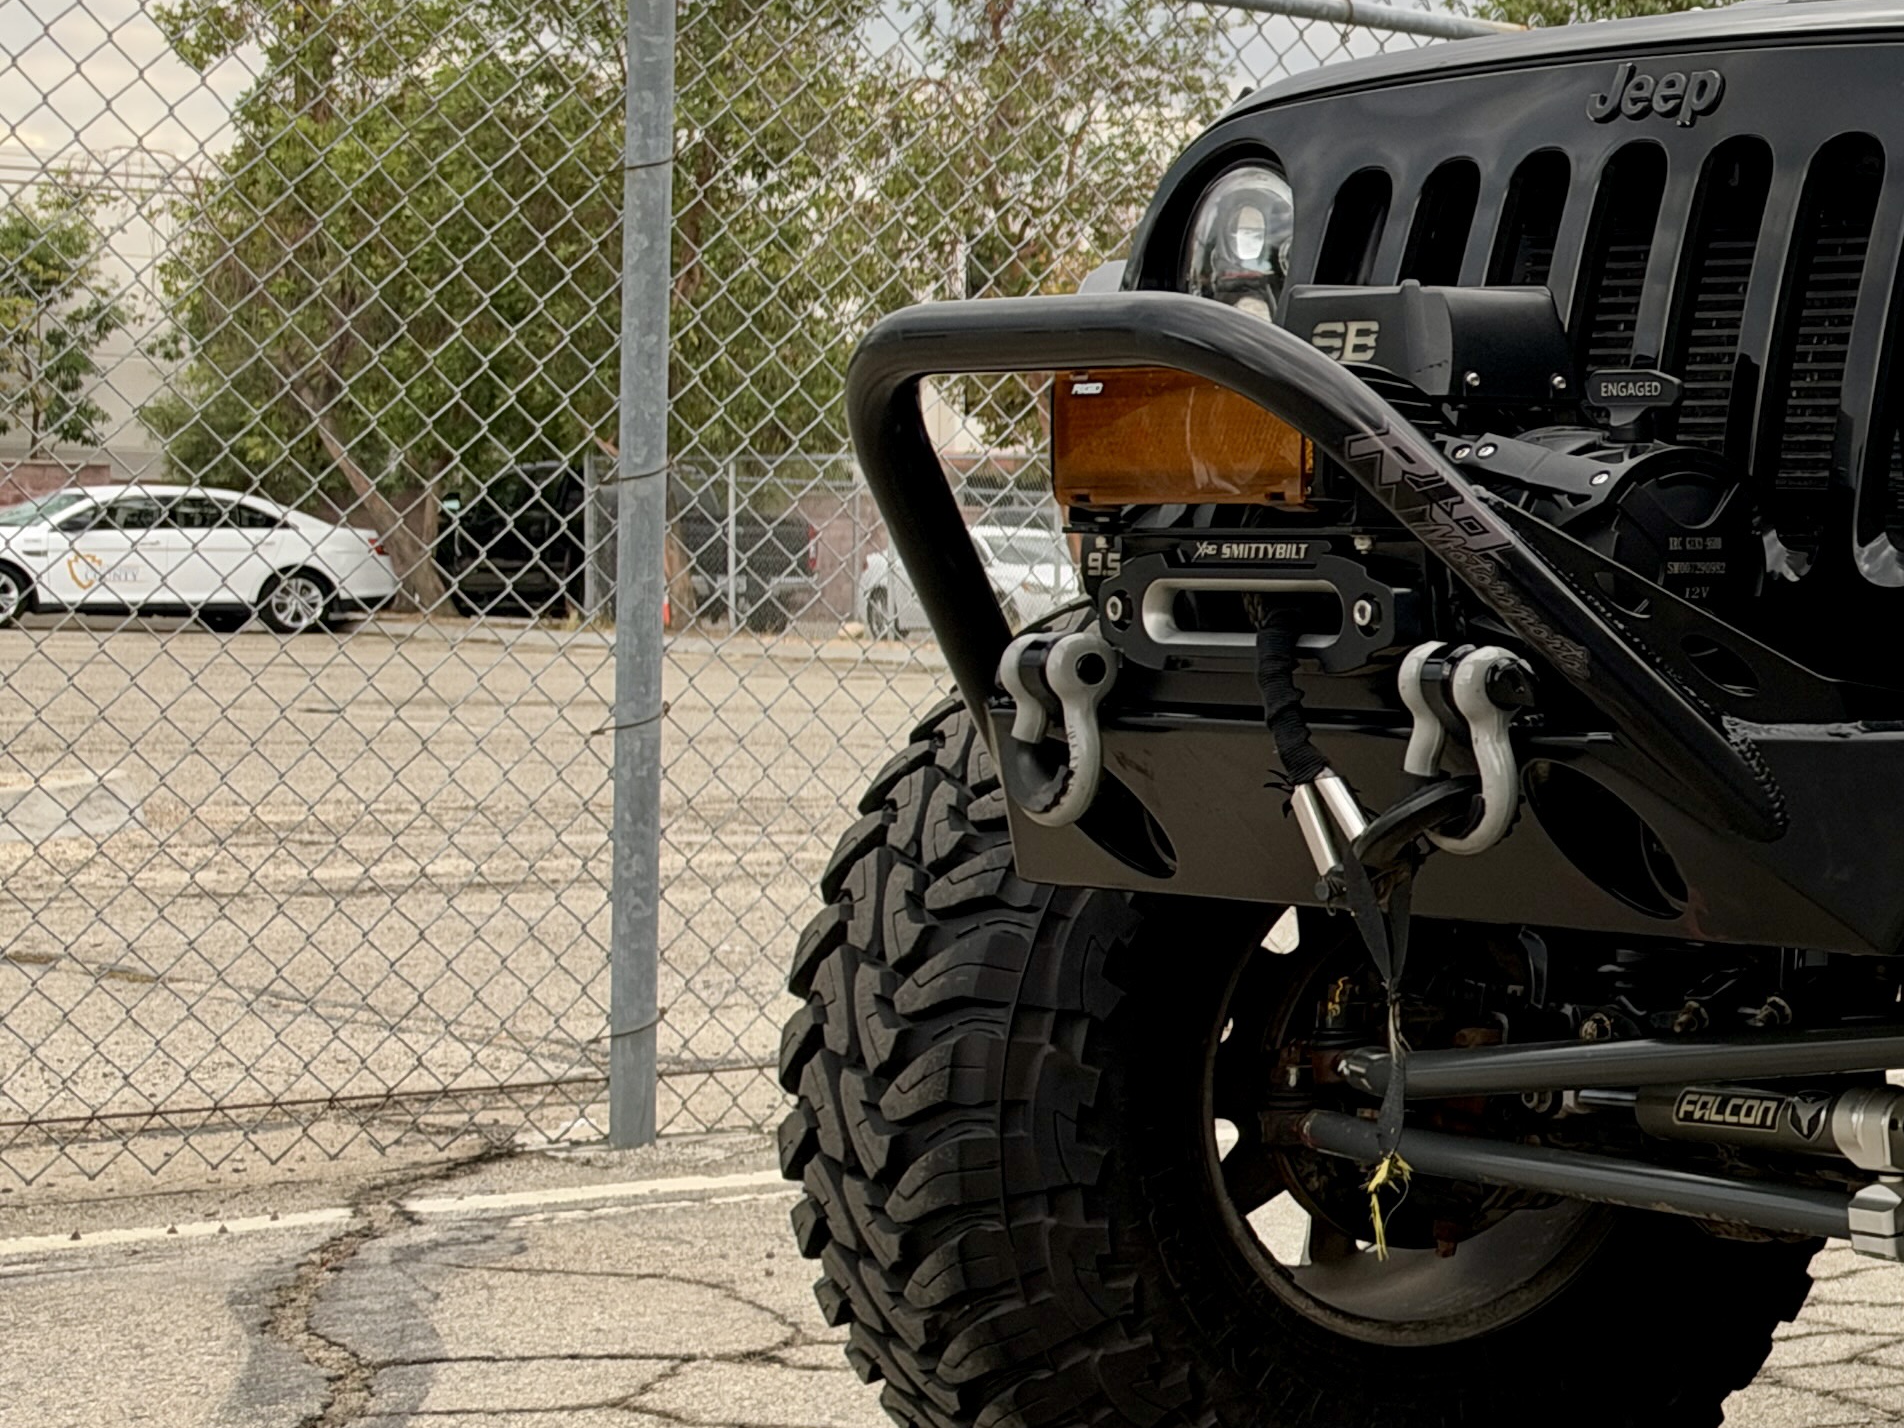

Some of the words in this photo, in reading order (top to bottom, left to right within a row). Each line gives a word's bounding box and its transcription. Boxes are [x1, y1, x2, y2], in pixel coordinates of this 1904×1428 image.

[1586, 62, 1725, 127] Jeep
[1600, 381, 1661, 397] ENGAGED
[1221, 543, 1309, 560] SMITTYBILT
[1087, 552, 1121, 576] 9.5
[1684, 586, 1710, 599] 12V
[1678, 1093, 1778, 1127] FALCON
